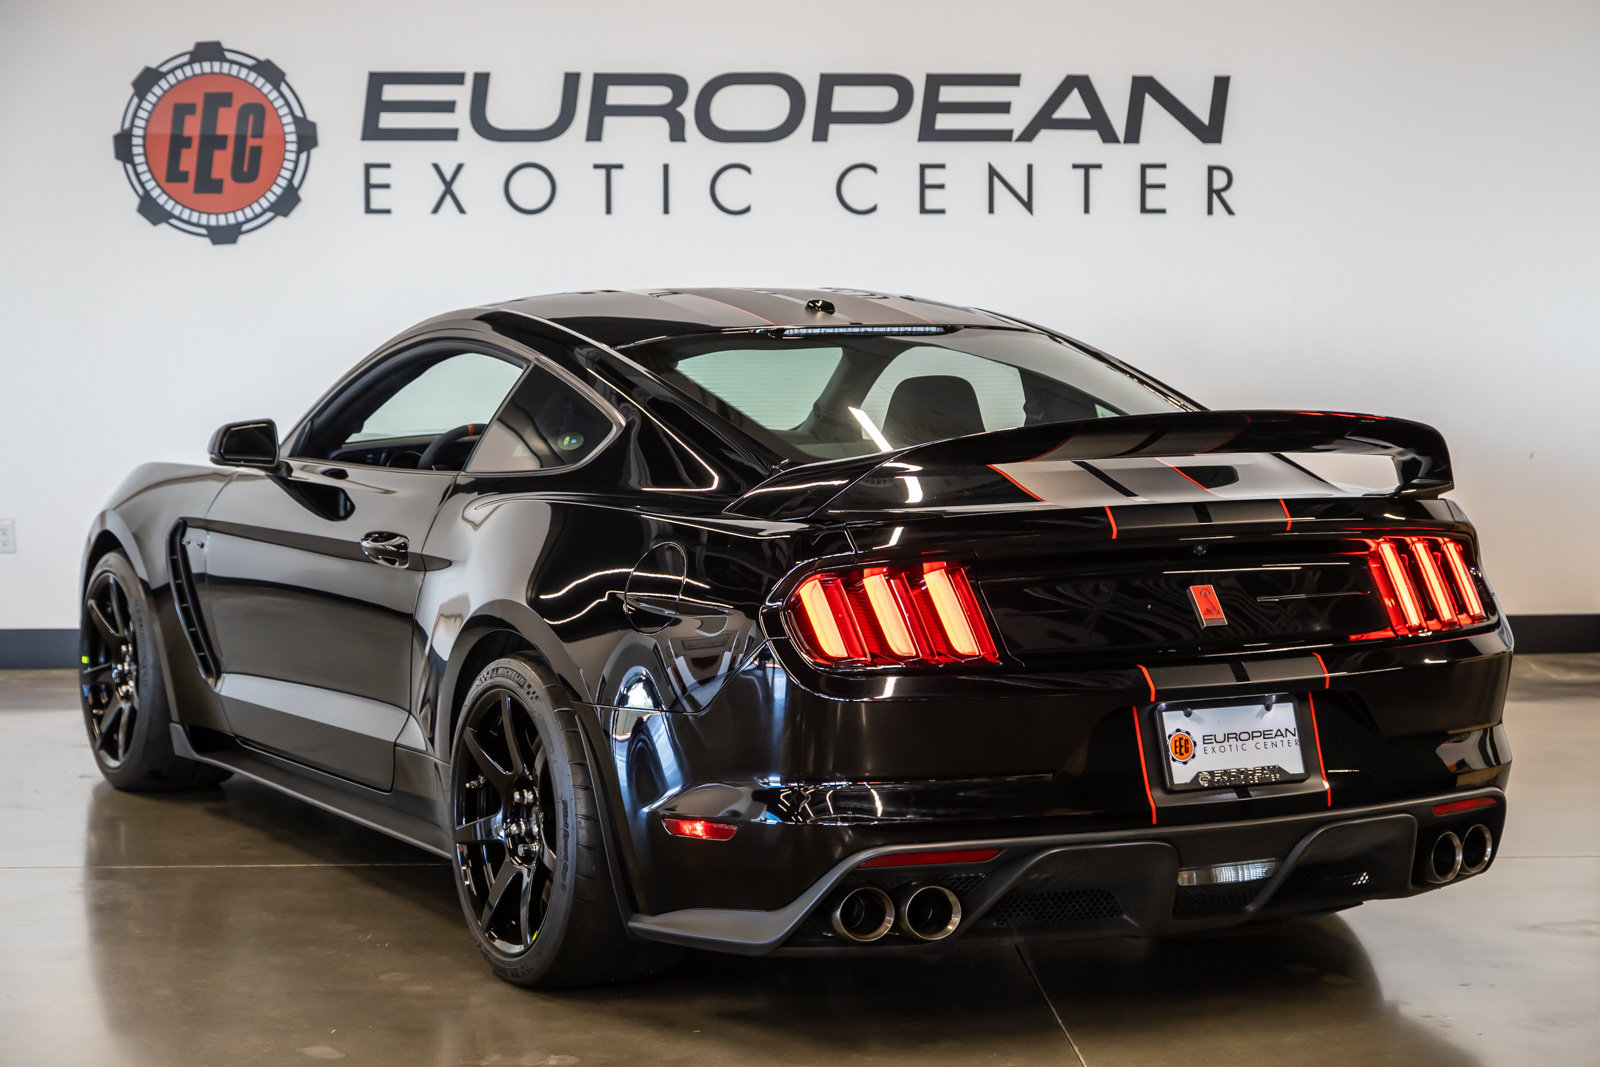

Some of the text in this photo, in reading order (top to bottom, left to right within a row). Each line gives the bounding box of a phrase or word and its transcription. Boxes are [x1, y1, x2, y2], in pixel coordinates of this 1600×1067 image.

[361, 72, 1230, 144] EUROPEAN
[165, 92, 266, 194] EEC
[365, 163, 1235, 215] EXOTIC CENTER
[497, 667, 526, 686] MICHELIN
[1202, 728, 1297, 745] EUROPEAN
[1203, 739, 1301, 755] EXOTIC CENTER
